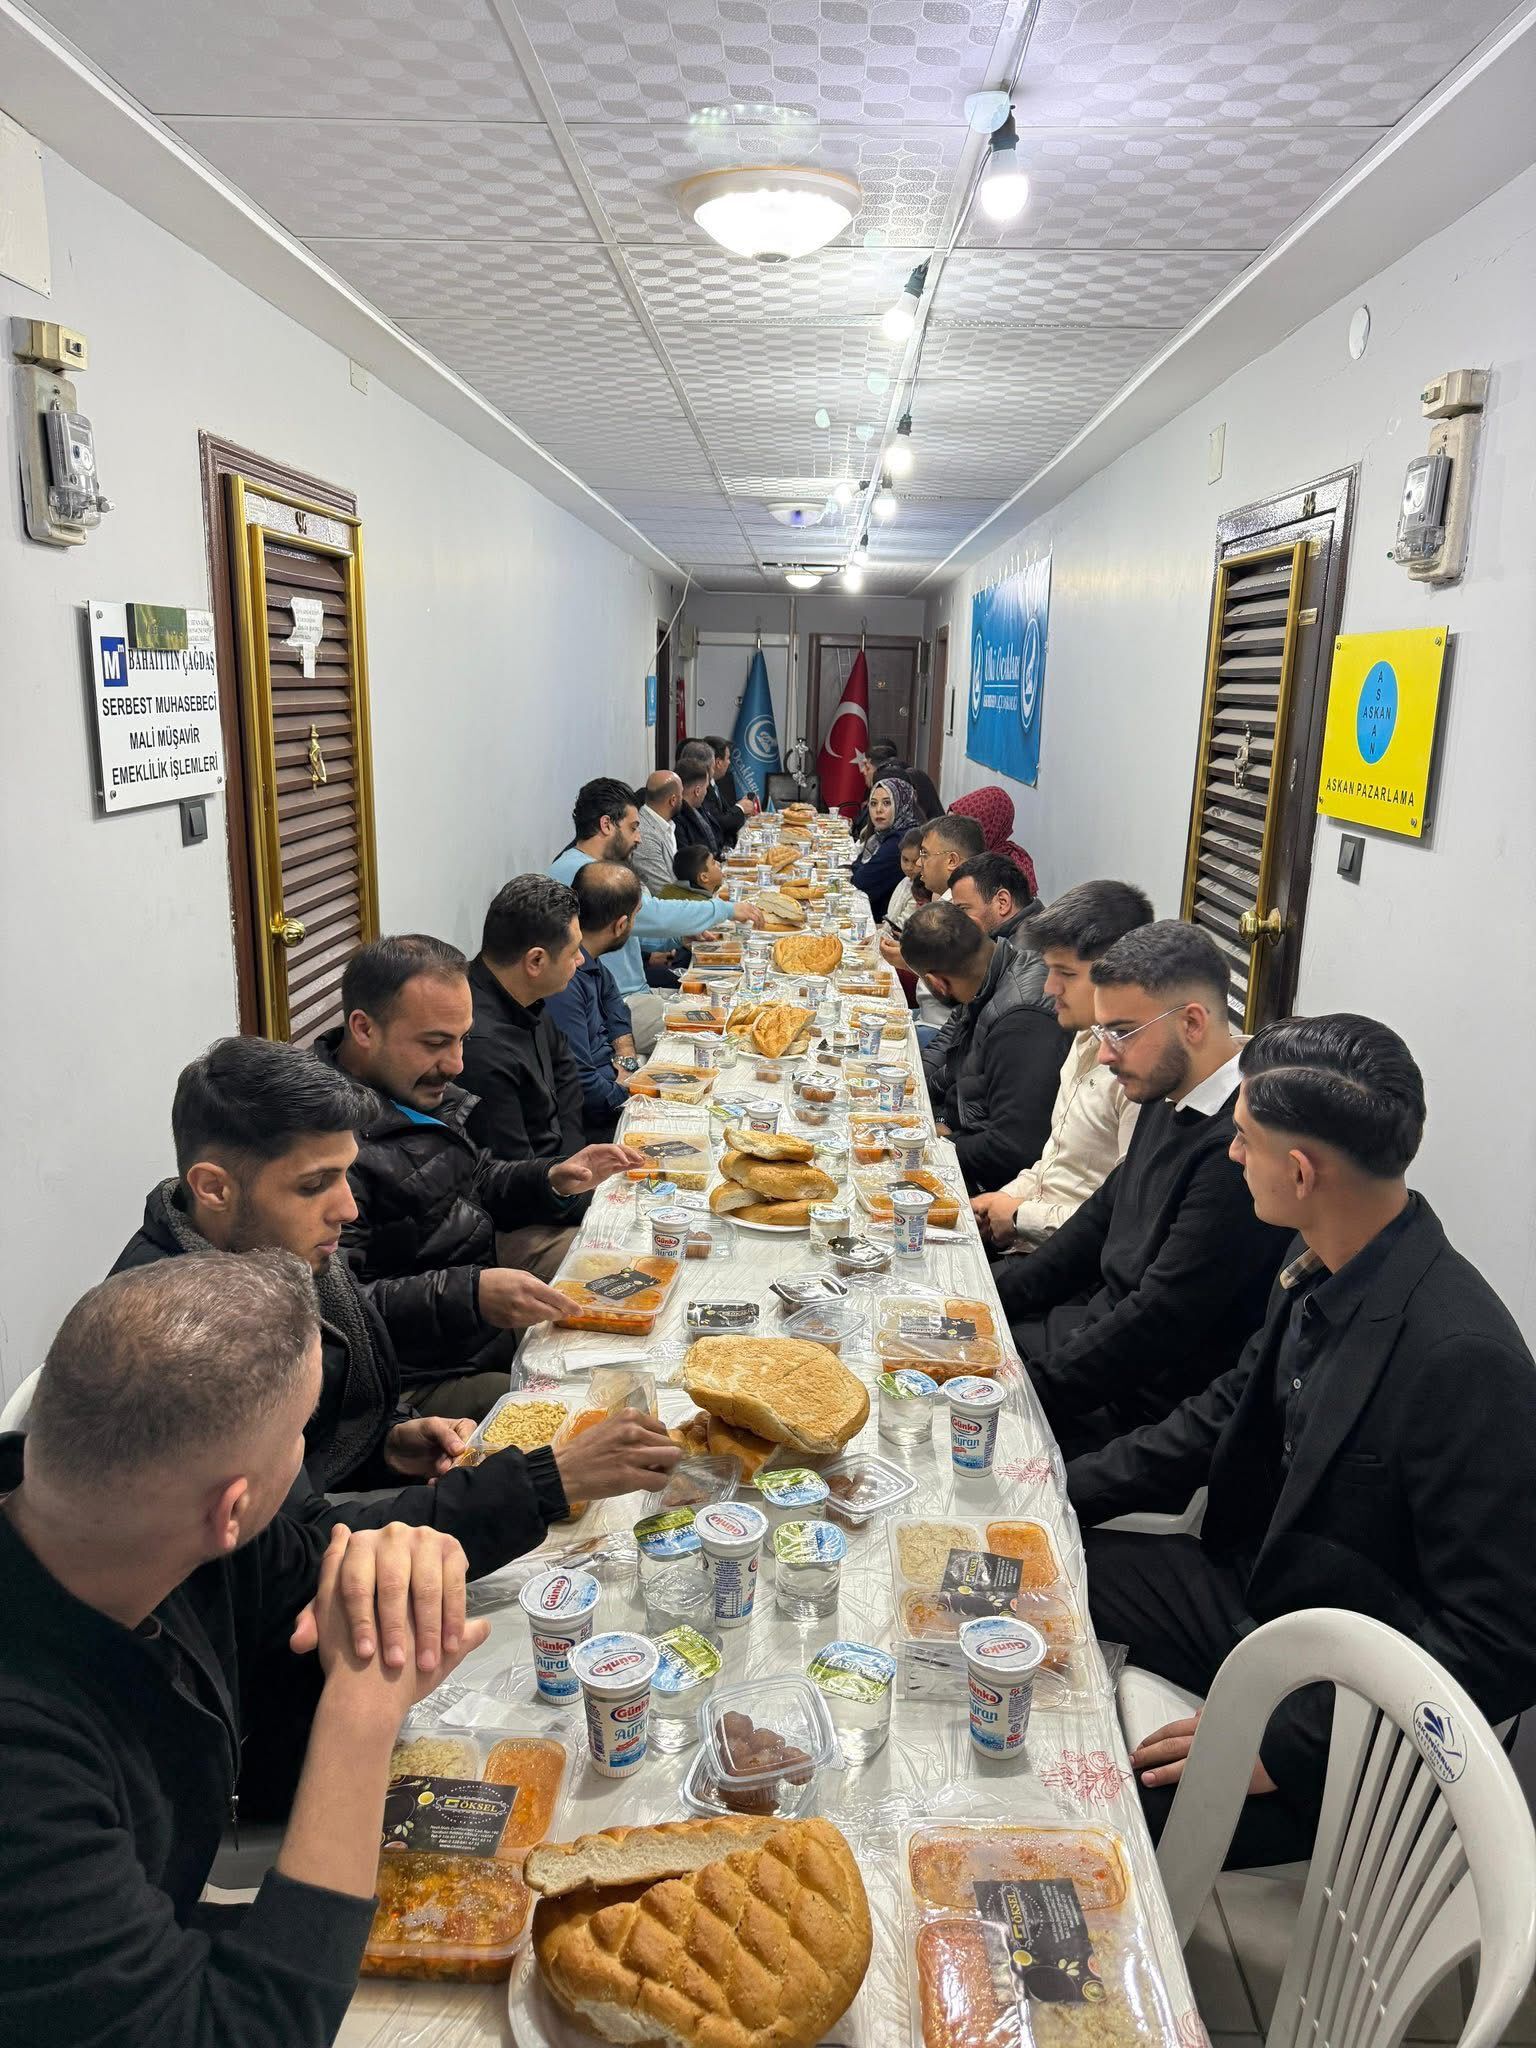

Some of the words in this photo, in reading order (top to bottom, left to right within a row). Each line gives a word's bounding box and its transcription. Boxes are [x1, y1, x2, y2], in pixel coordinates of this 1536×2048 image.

[182, 646, 215, 676] ÇAĞDAŞ
[102, 697, 152, 716] SERBEST
[155, 692, 217, 714] MUHASEBECİ
[1362, 706, 1392, 720] ASKAN
[129, 726, 155, 750] MALİ
[157, 724, 200, 750] MÜŞAVİR
[112, 759, 168, 785] EMEKLİLİK
[169, 752, 219, 781] İŞLEMLERİ
[1326, 777, 1355, 795] ASKAN
[1357, 782, 1415, 807] PAZARLAMA
[953, 1418, 978, 1432] Günka
[709, 1514, 743, 1536] Günka
[545, 1579, 566, 1608] Günka
[535, 1637, 570, 1651] Günka
[981, 1640, 1026, 1654] Günka
[594, 1654, 641, 1675] Günka
